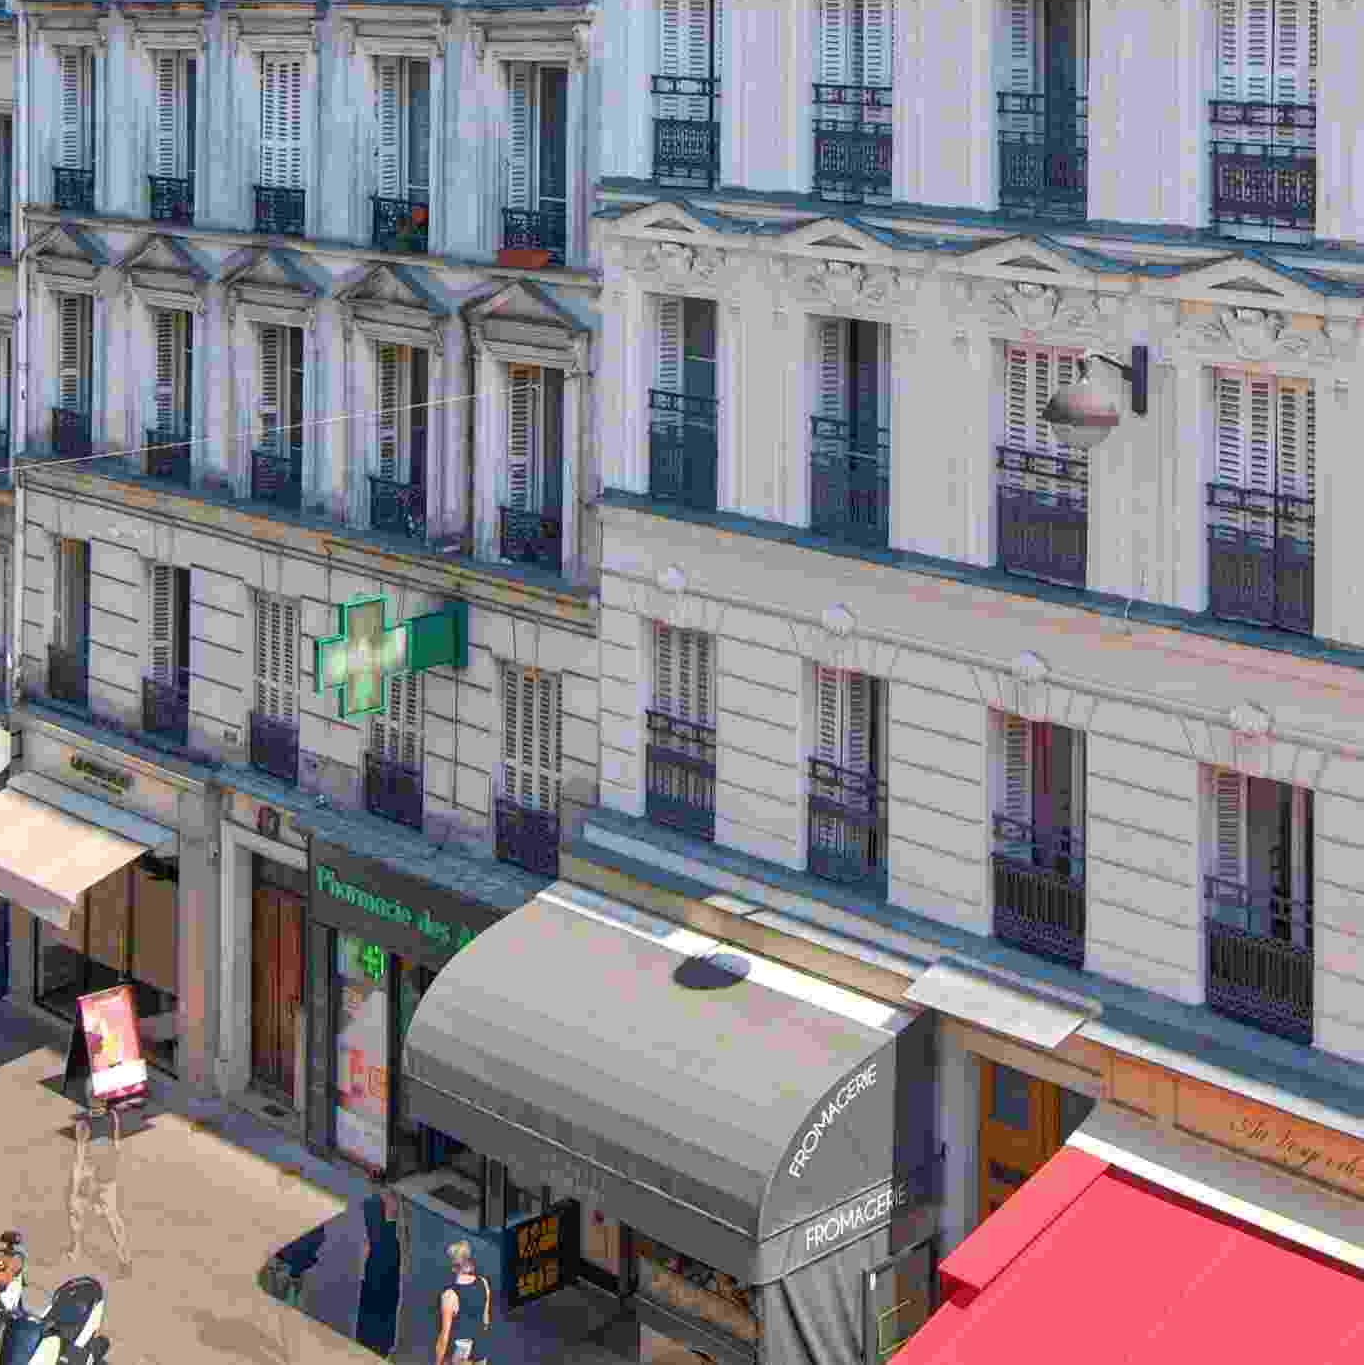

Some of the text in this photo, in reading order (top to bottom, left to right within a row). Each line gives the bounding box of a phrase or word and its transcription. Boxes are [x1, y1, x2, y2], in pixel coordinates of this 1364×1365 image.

[316, 865, 413, 923] Pharmacie
[788, 1063, 877, 1179] FROMAGERIE
[805, 1182, 908, 1252] FROMAGERIE
